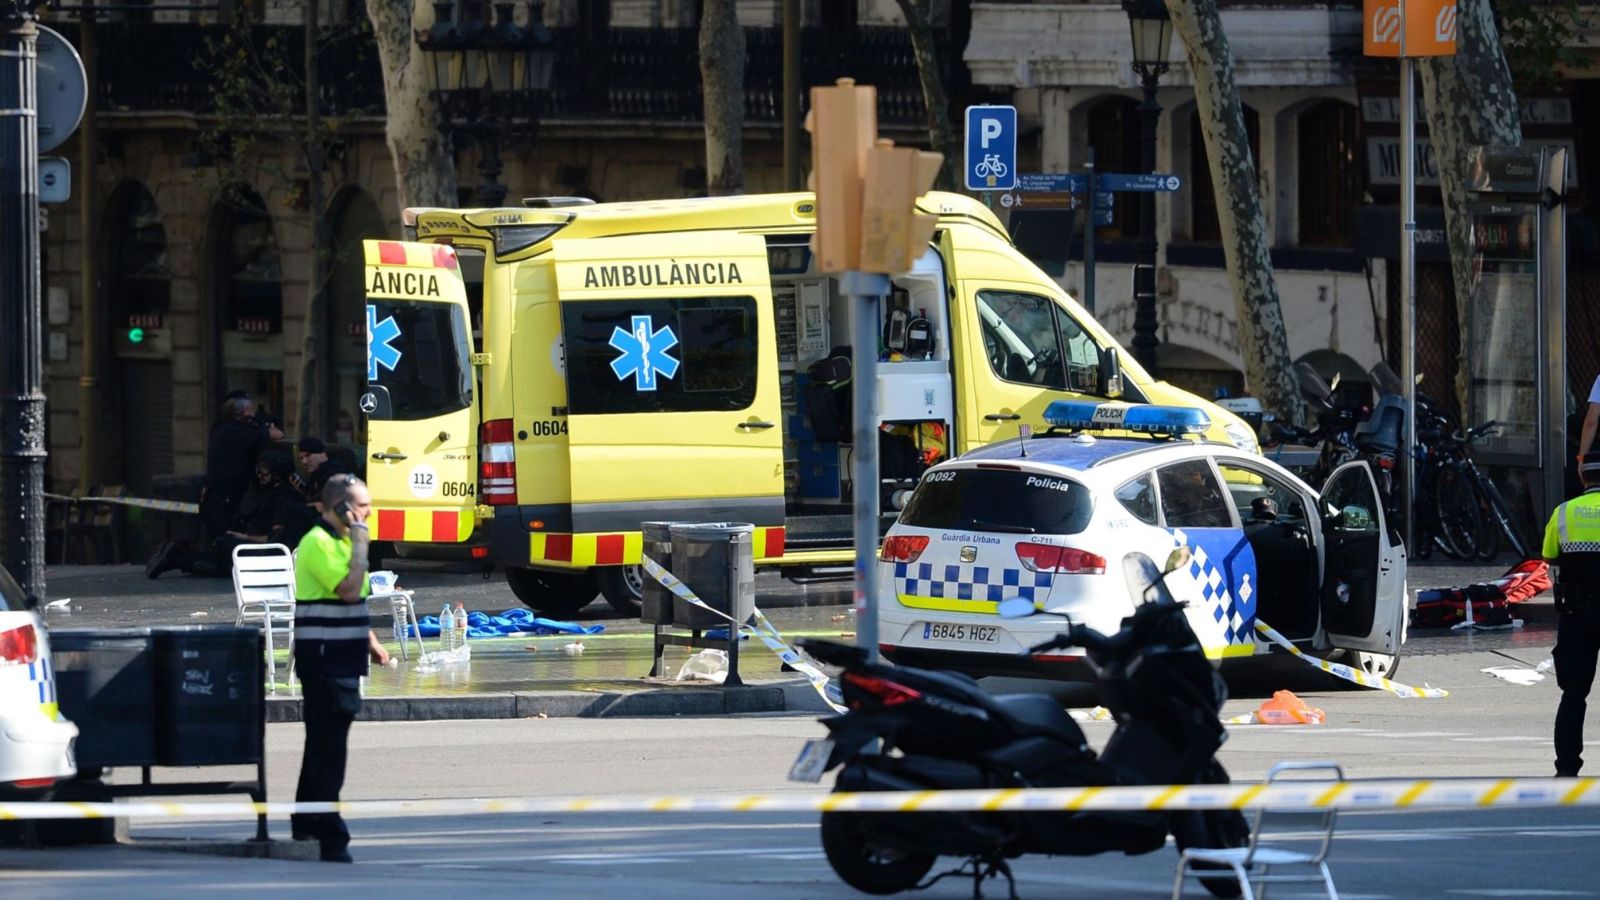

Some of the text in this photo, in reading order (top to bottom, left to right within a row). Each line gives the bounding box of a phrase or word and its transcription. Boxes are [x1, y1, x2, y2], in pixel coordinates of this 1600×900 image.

[981, 118, 1003, 149] P
[584, 258, 743, 288] AMBULÀNCIA
[130, 315, 160, 327] CASAS
[238, 319, 270, 332] CASAS
[1096, 407, 1123, 419] POLICIA
[533, 420, 568, 436] 0604
[414, 473, 434, 486] 112
[1026, 476, 1069, 492] Policia
[442, 481, 476, 498] 0604
[972, 534, 1000, 545] Urbana
[1031, 536, 1053, 545] C-711
[932, 624, 965, 641] 6845
[969, 626, 996, 642] HGZ
